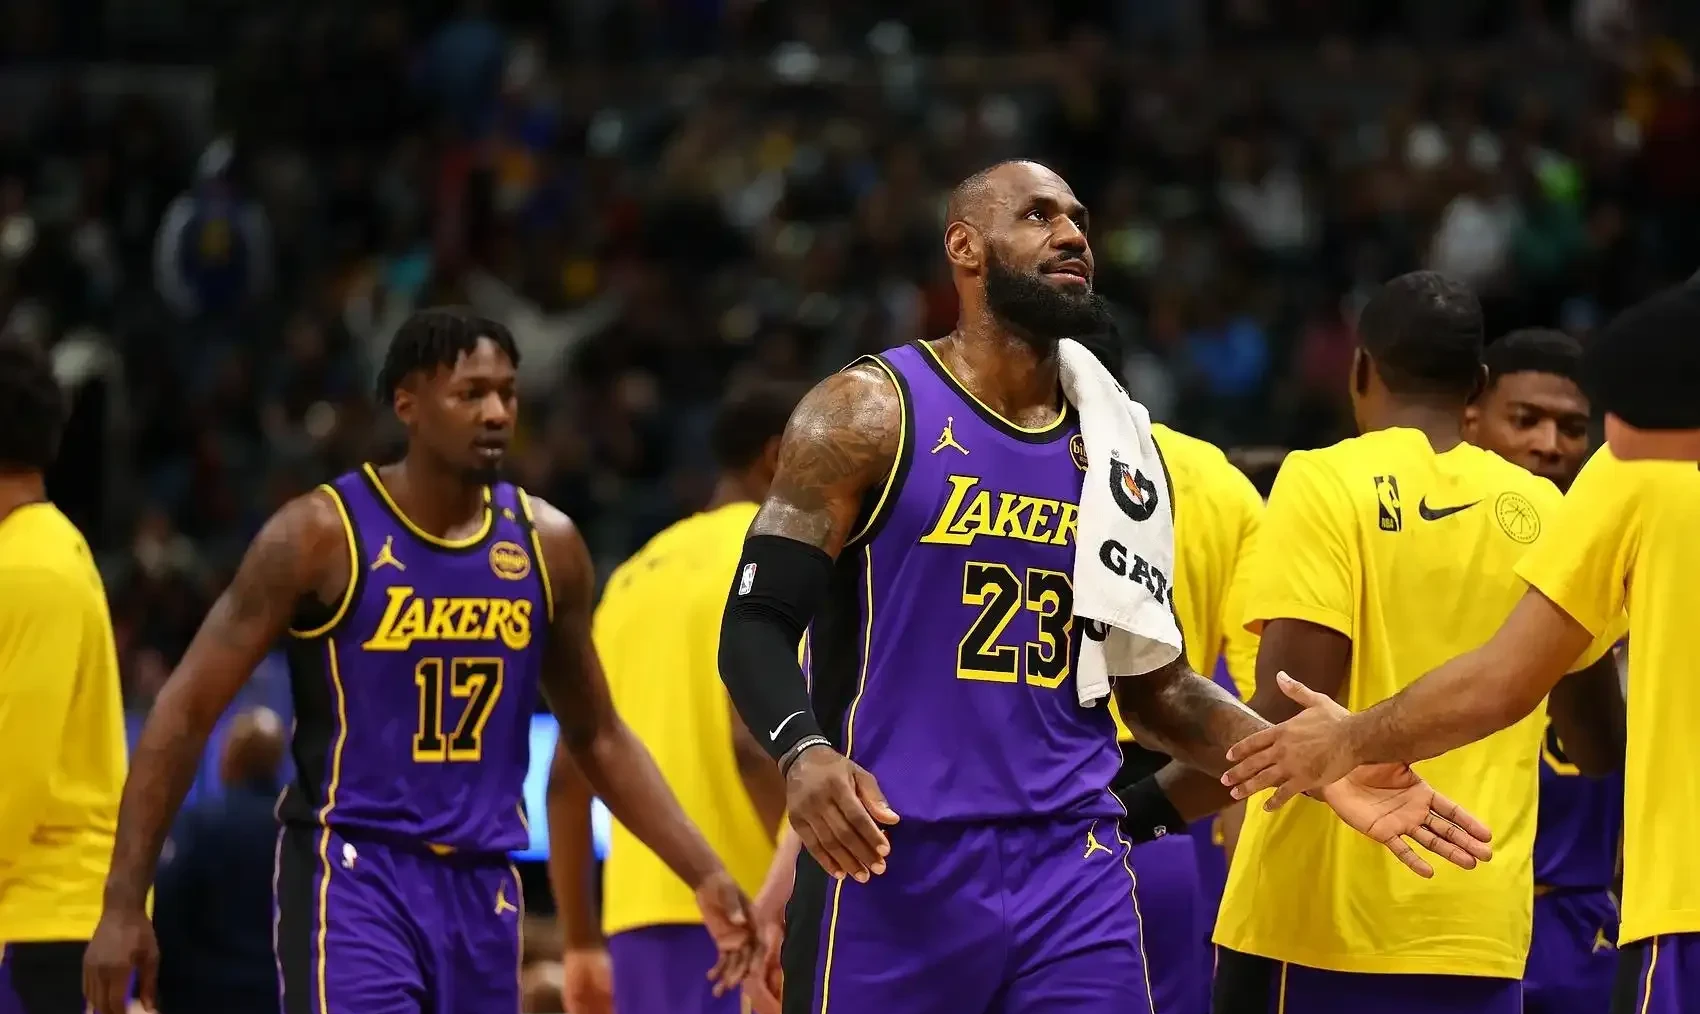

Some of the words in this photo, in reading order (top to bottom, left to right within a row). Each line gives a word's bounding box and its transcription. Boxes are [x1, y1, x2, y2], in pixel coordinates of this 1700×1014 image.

[919, 474, 1080, 546] LAKER
[361, 586, 533, 650] LAKERS
[956, 561, 1074, 689] 23
[412, 657, 504, 762] 17
